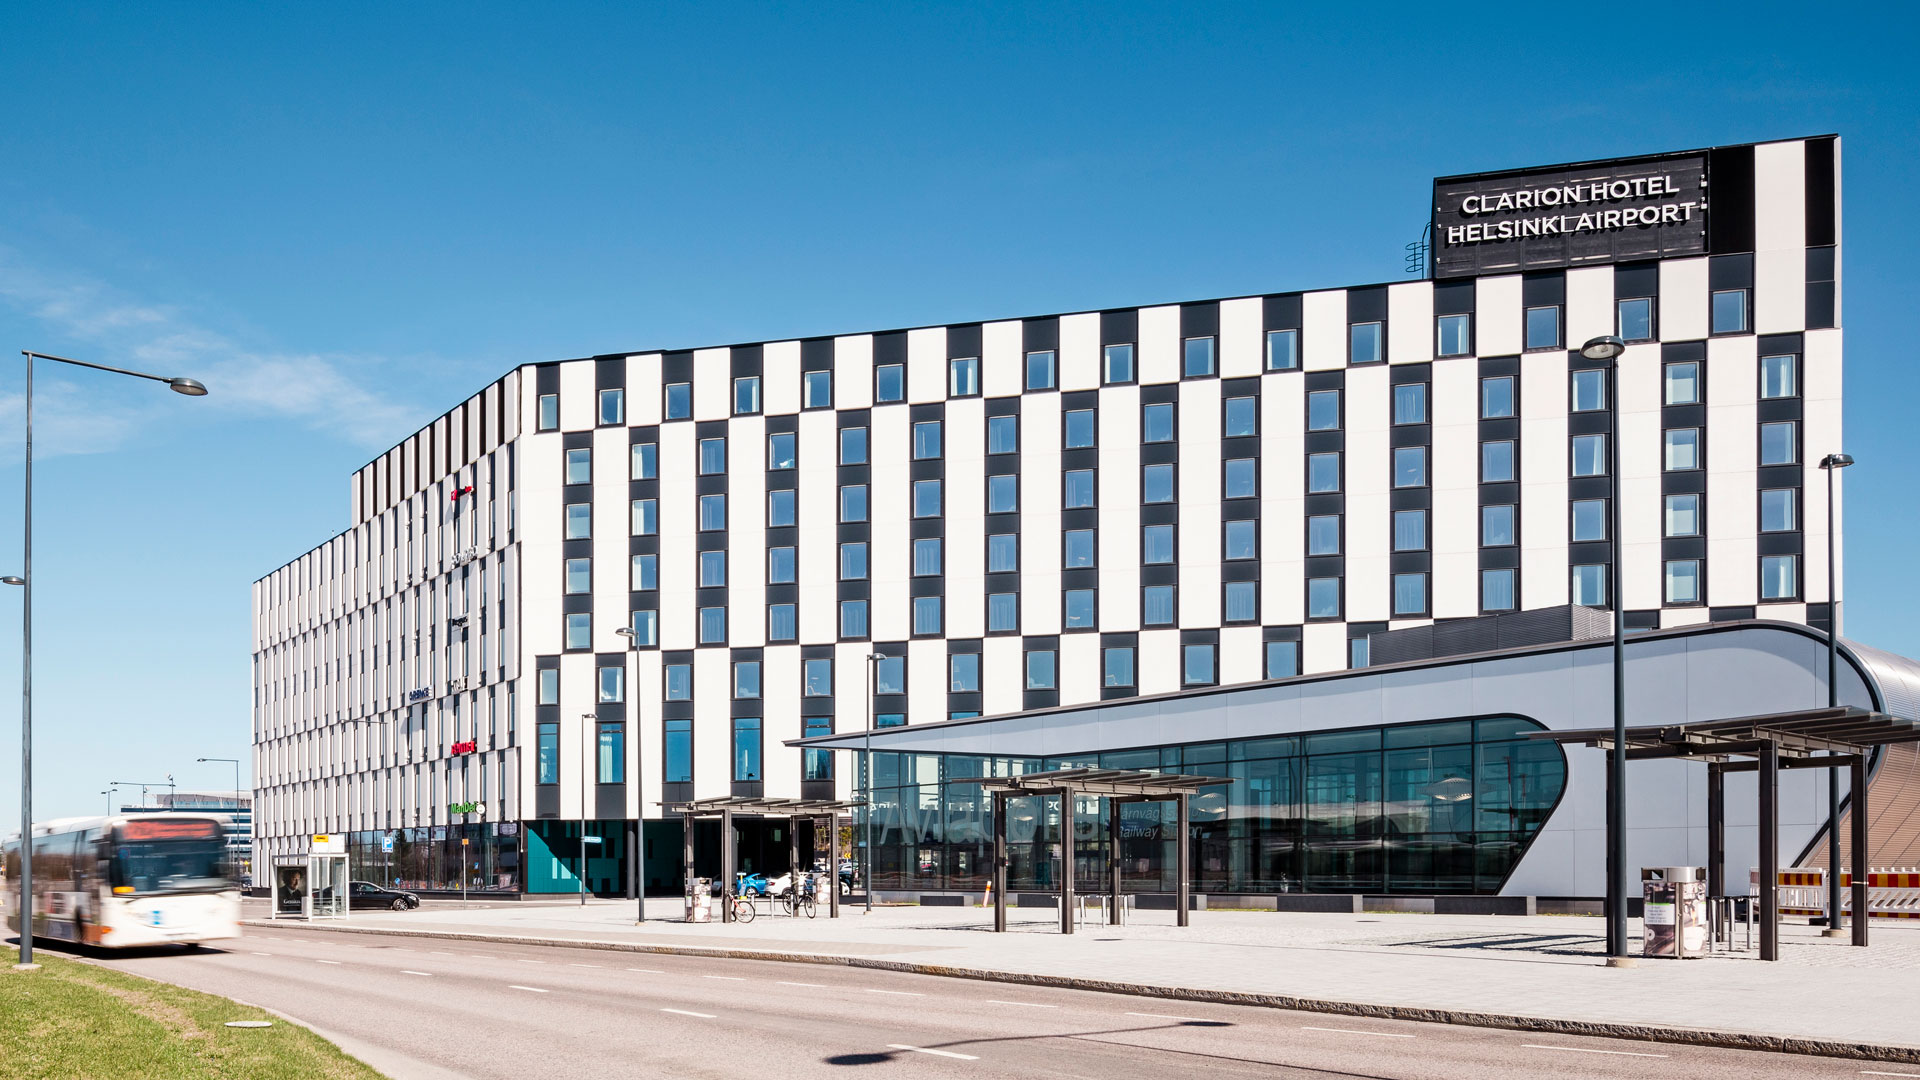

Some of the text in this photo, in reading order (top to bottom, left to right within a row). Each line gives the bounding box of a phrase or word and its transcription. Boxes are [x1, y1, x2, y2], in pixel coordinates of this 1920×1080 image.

[1462, 175, 1680, 214] CLARION HOTEL
[1448, 201, 1697, 244] HELSINKI AIRPORT
